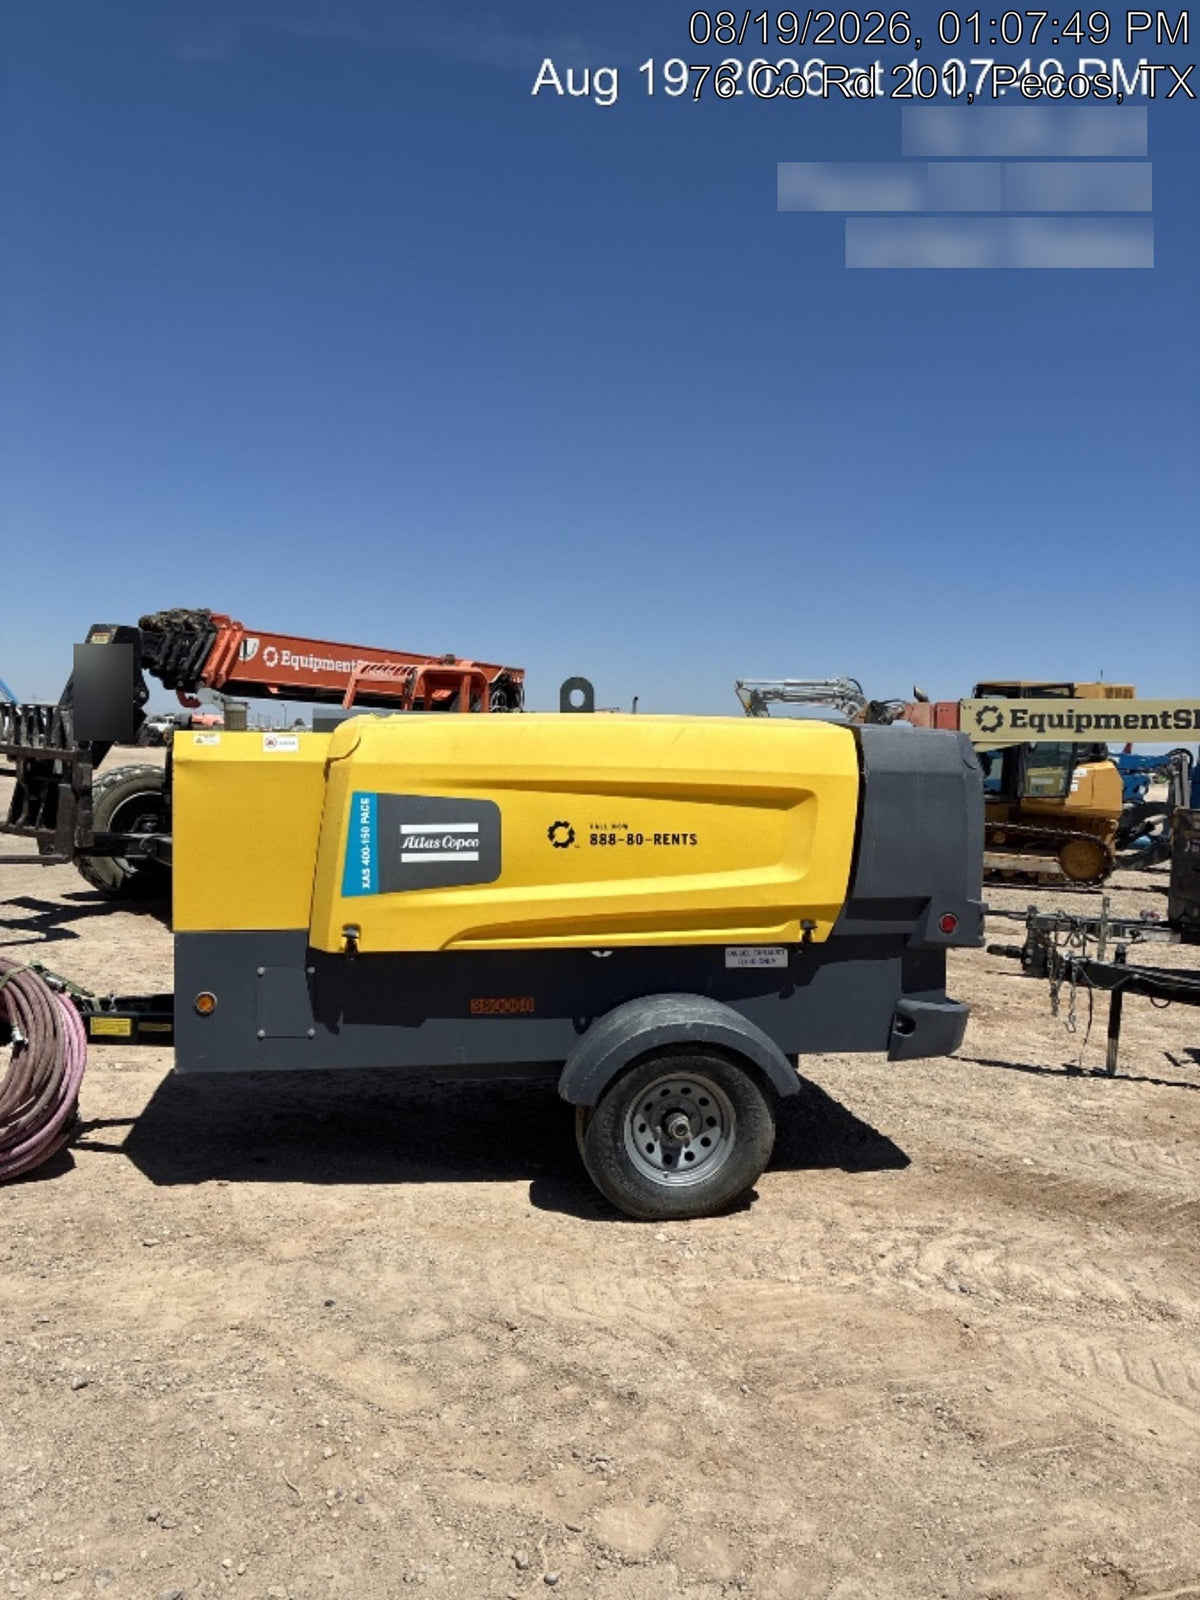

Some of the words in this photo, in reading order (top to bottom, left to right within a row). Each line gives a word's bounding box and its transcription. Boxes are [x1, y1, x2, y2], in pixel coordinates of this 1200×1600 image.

[360, 797, 371, 824] PACE
[360, 826, 371, 866] 400-150
[401, 835, 441, 849] Atlas
[441, 834, 480, 851] Copco
[589, 833, 698, 846] 888-80-RENTS
[361, 867, 371, 889] XAS
